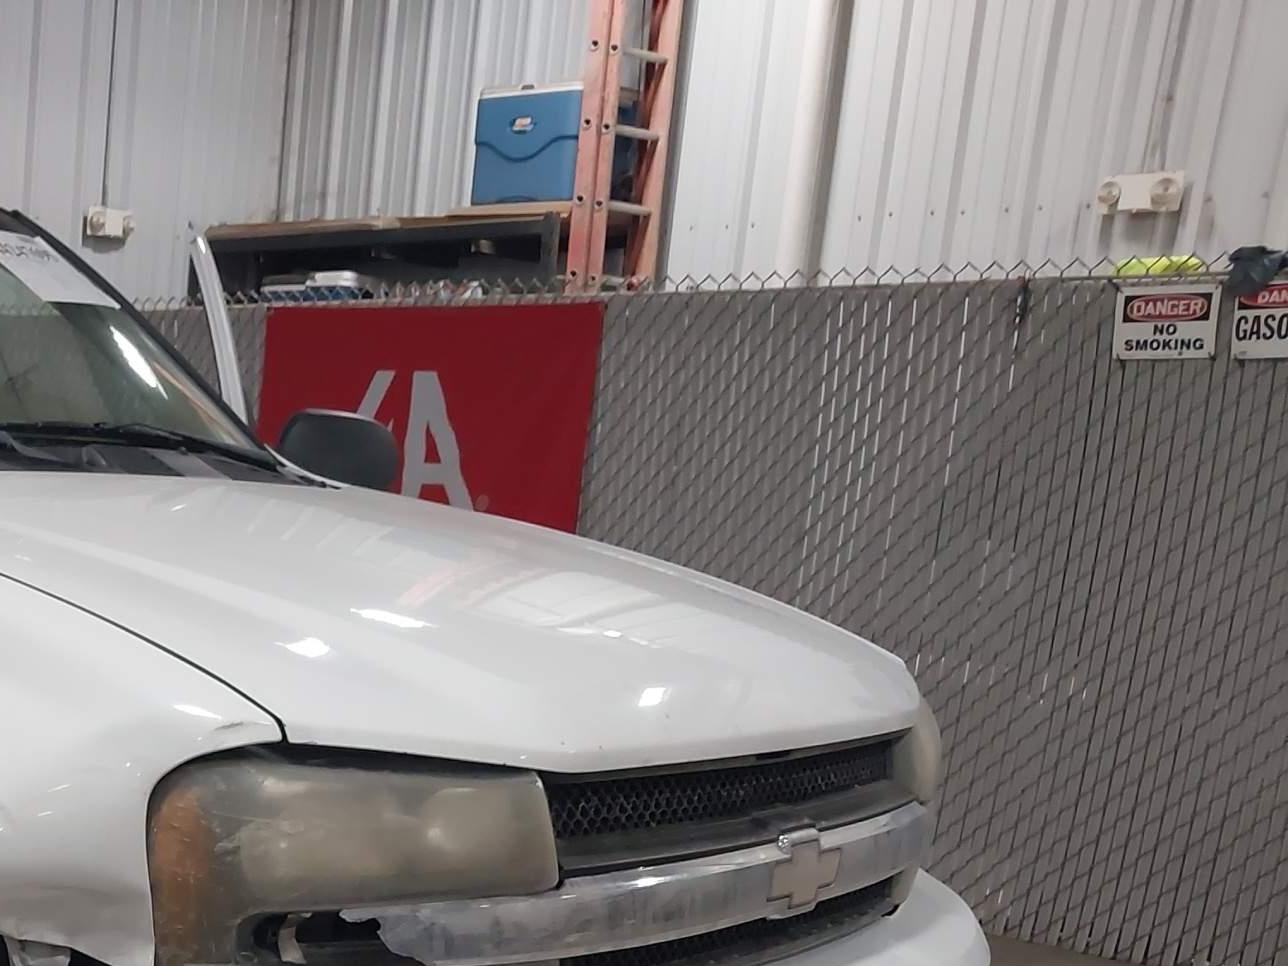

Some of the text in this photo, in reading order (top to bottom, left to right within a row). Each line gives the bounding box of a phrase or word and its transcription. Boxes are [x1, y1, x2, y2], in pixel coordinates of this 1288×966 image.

[1132, 299, 1202, 316] DANGER
[1153, 323, 1177, 336] NO
[1235, 313, 1288, 341] GASO
[1124, 338, 1204, 351] SMOKING
